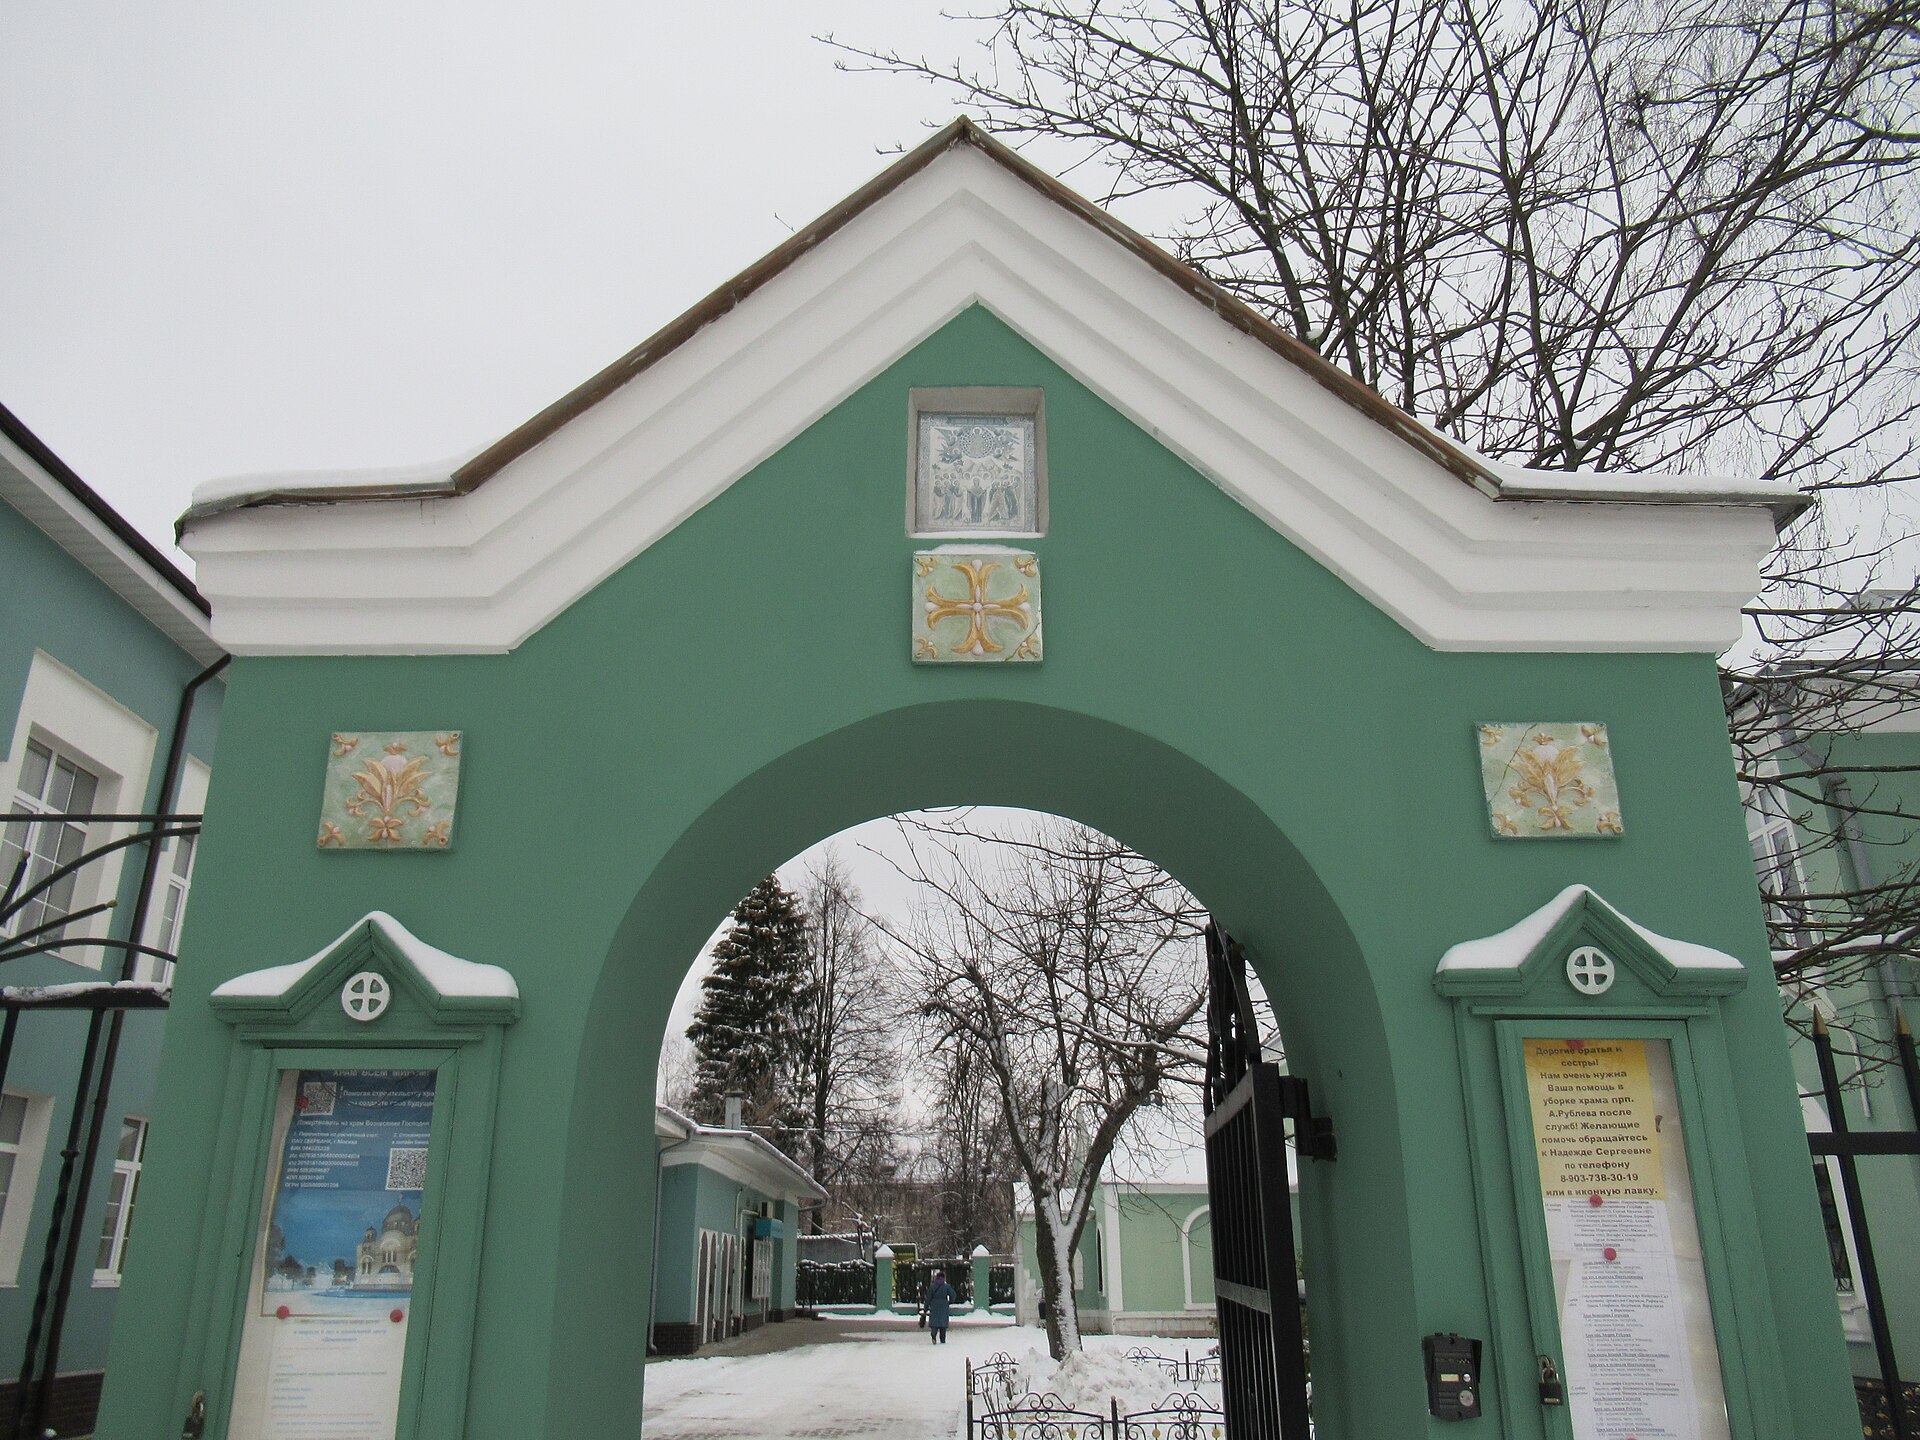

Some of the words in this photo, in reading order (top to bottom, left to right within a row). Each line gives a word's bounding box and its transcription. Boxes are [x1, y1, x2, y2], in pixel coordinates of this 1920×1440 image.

[1535, 1047, 1575, 1056] Дорогие
[1561, 1059, 1599, 1068] сестры!
[1593, 1071, 1628, 1080] нужна
[1547, 1084, 1574, 1092] Ваша
[1576, 1084, 1615, 1092] помощь
[1542, 1097, 1576, 1106] уборке
[1578, 1097, 1609, 1106] храма
[1611, 1097, 1635, 1105] прп.
[1549, 1109, 1597, 1119] А.Рублева
[1599, 1109, 1632, 1117] после
[1545, 1122, 1578, 1132] служб!
[1580, 1122, 1640, 1130] Желающие
[1541, 1136, 1577, 1144] помочь
[1578, 1134, 1648, 1144] обращайтесь
[1549, 1149, 1593, 1157] Надежде
[1595, 1148, 1652, 1157] Сергеевне
[1578, 1161, 1630, 1170] телефону
[1560, 1173, 1639, 1183] 8-903-738-30-19
[1575, 1188, 1621, 1197] иконную
[1624, 1187, 1658, 1196] лавку.
